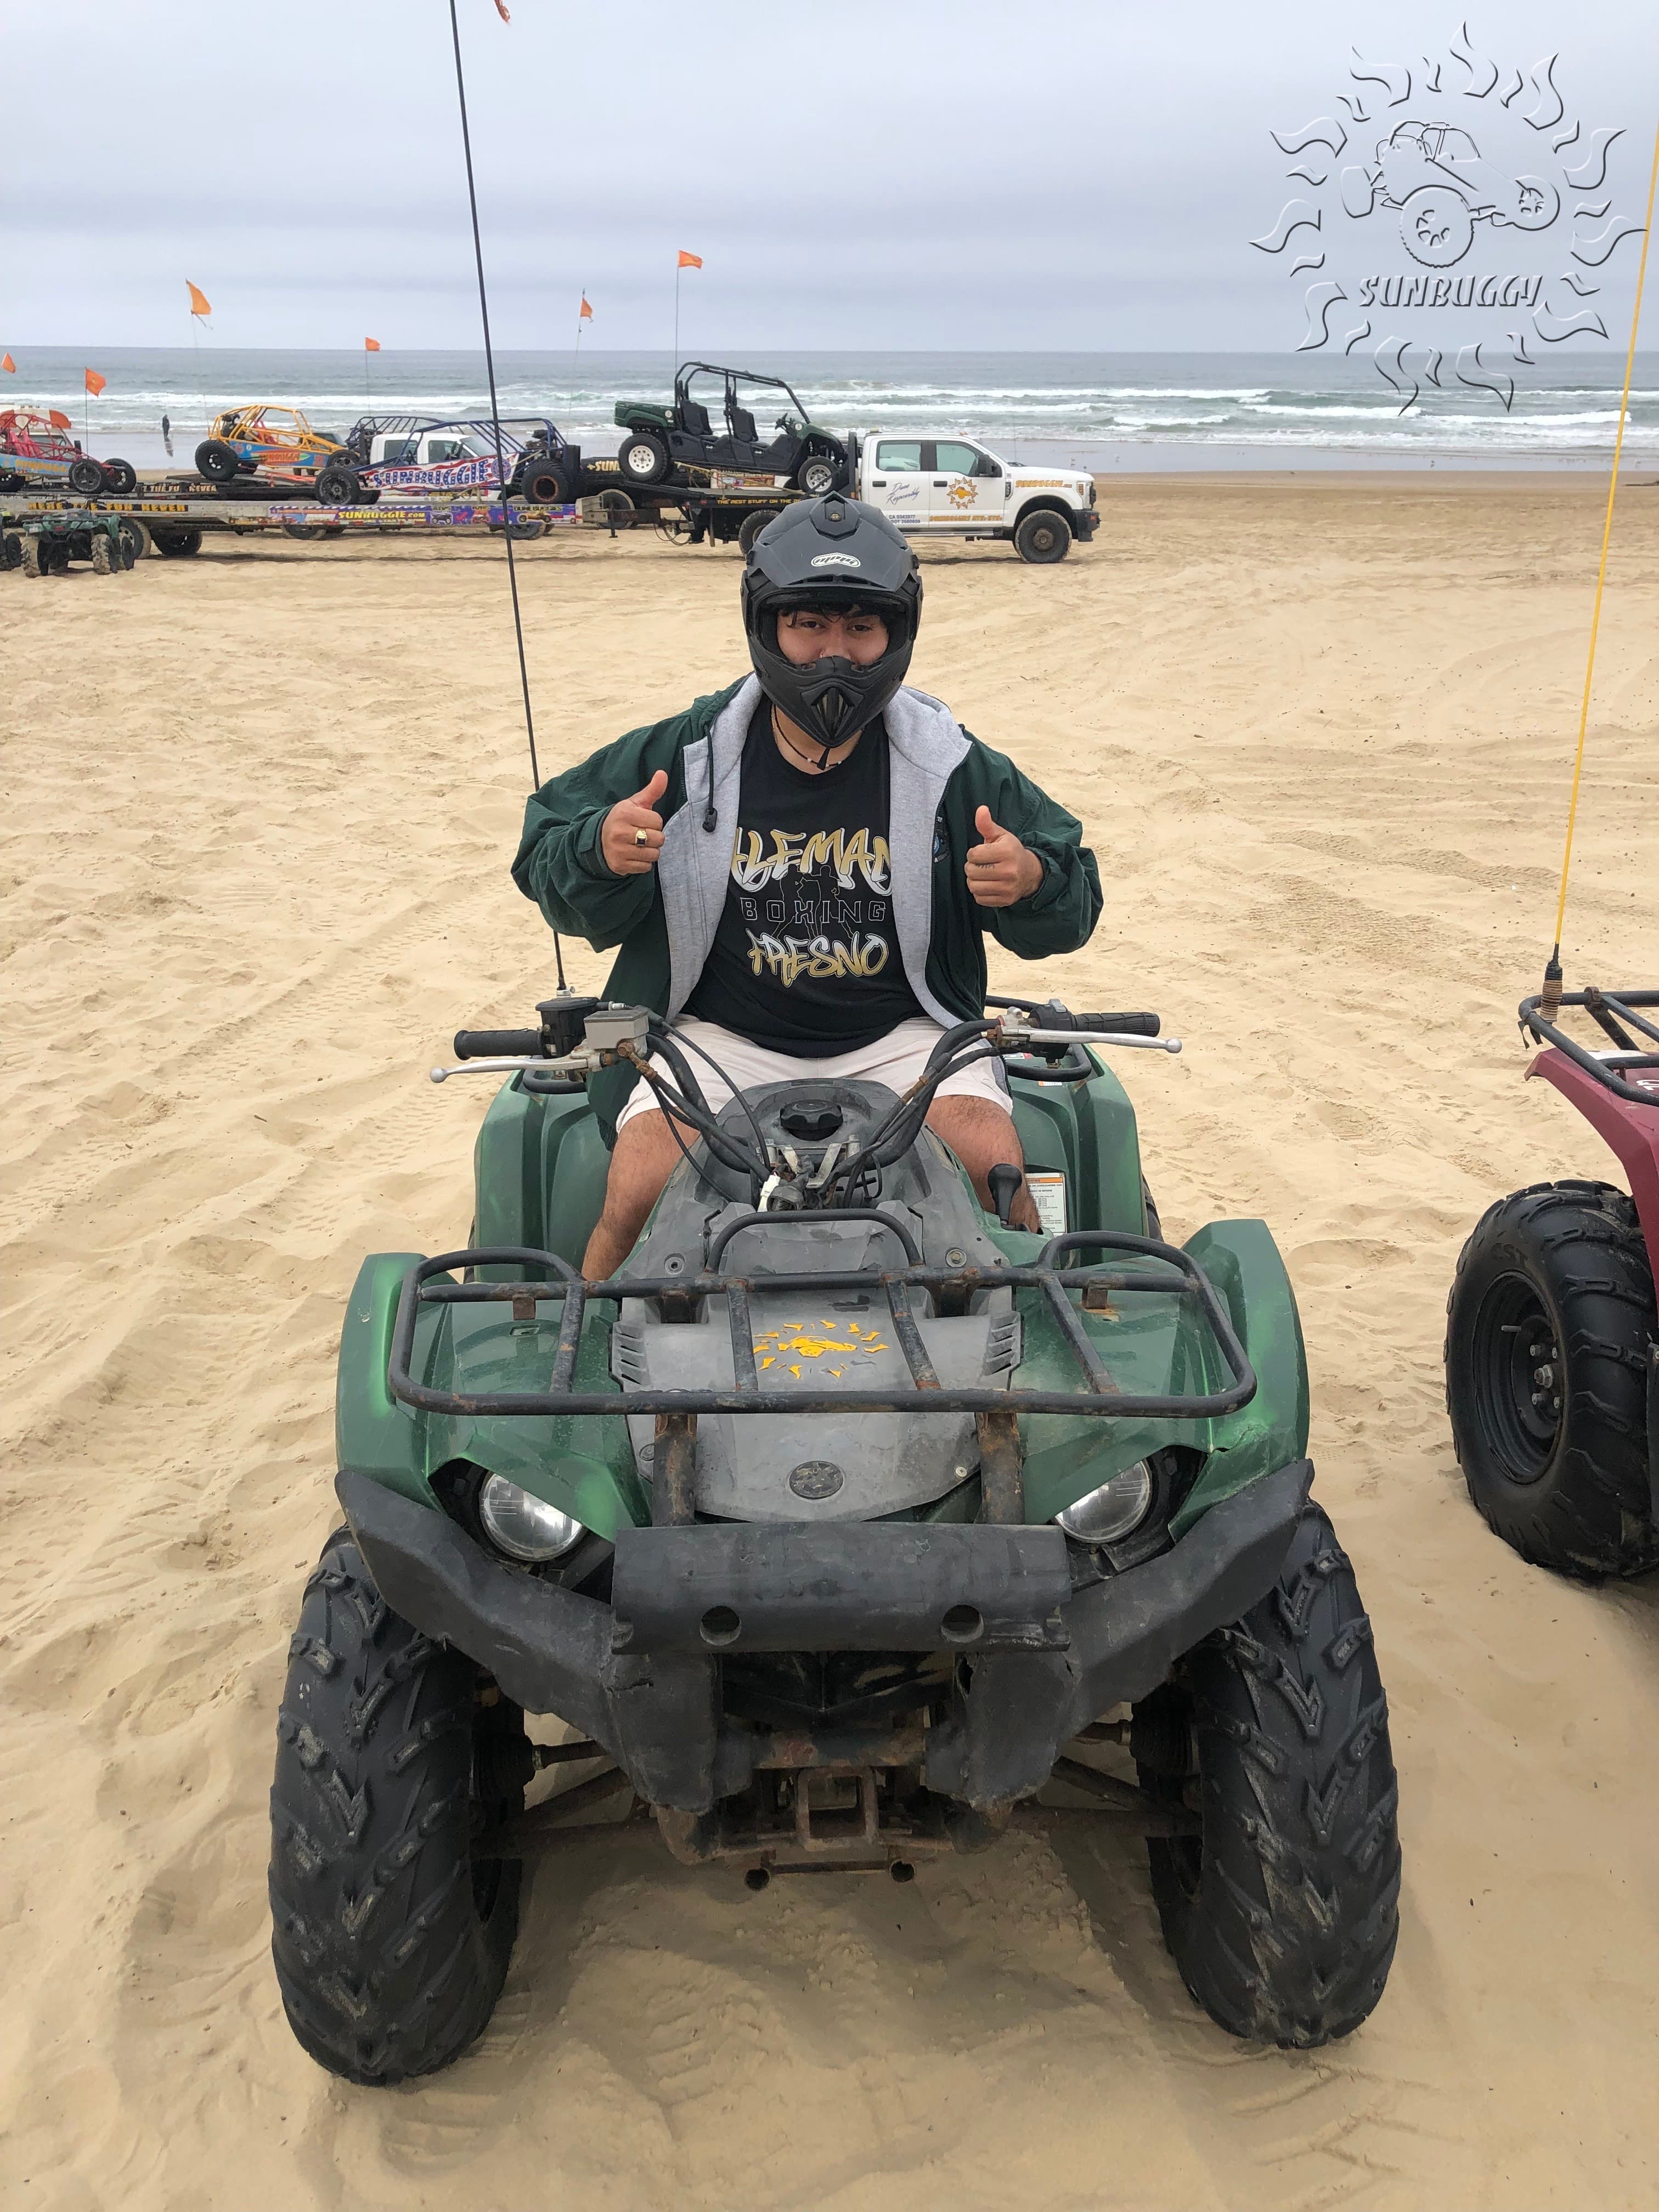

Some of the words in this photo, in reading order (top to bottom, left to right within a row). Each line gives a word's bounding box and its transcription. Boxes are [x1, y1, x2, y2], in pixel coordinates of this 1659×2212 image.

[373, 459, 488, 488] SUNBUGGIE
[594, 460, 620, 471] SUN
[141, 503, 187, 511] NEVER
[740, 897, 886, 924] BOXING
[745, 928, 889, 988] FRESNO
